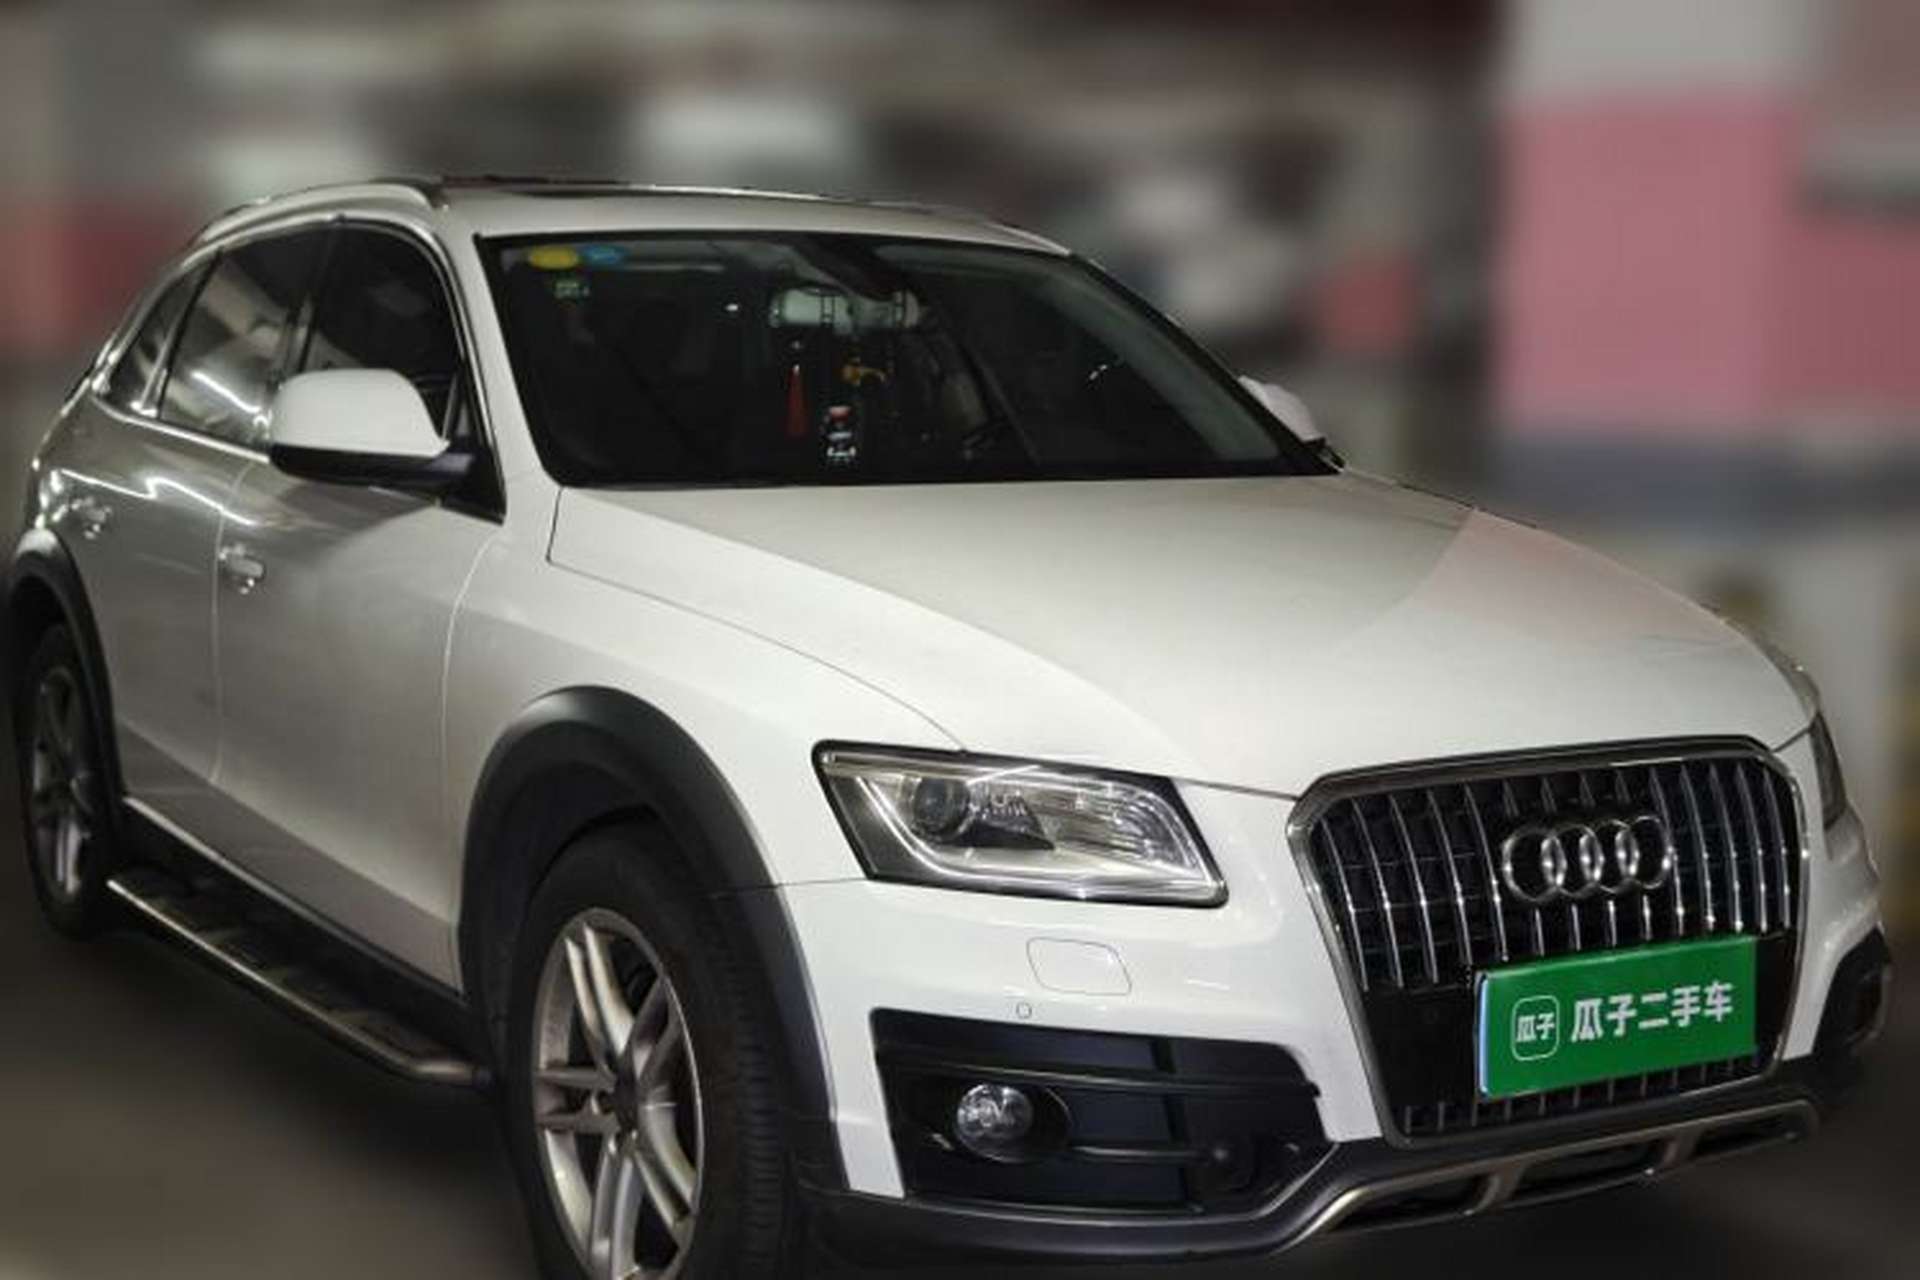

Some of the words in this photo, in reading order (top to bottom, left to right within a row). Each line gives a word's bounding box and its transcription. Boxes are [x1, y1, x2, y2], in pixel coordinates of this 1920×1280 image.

[1516, 1013, 1555, 1042] 瓜子
[1571, 980, 1733, 1042] 瓜子二手车
